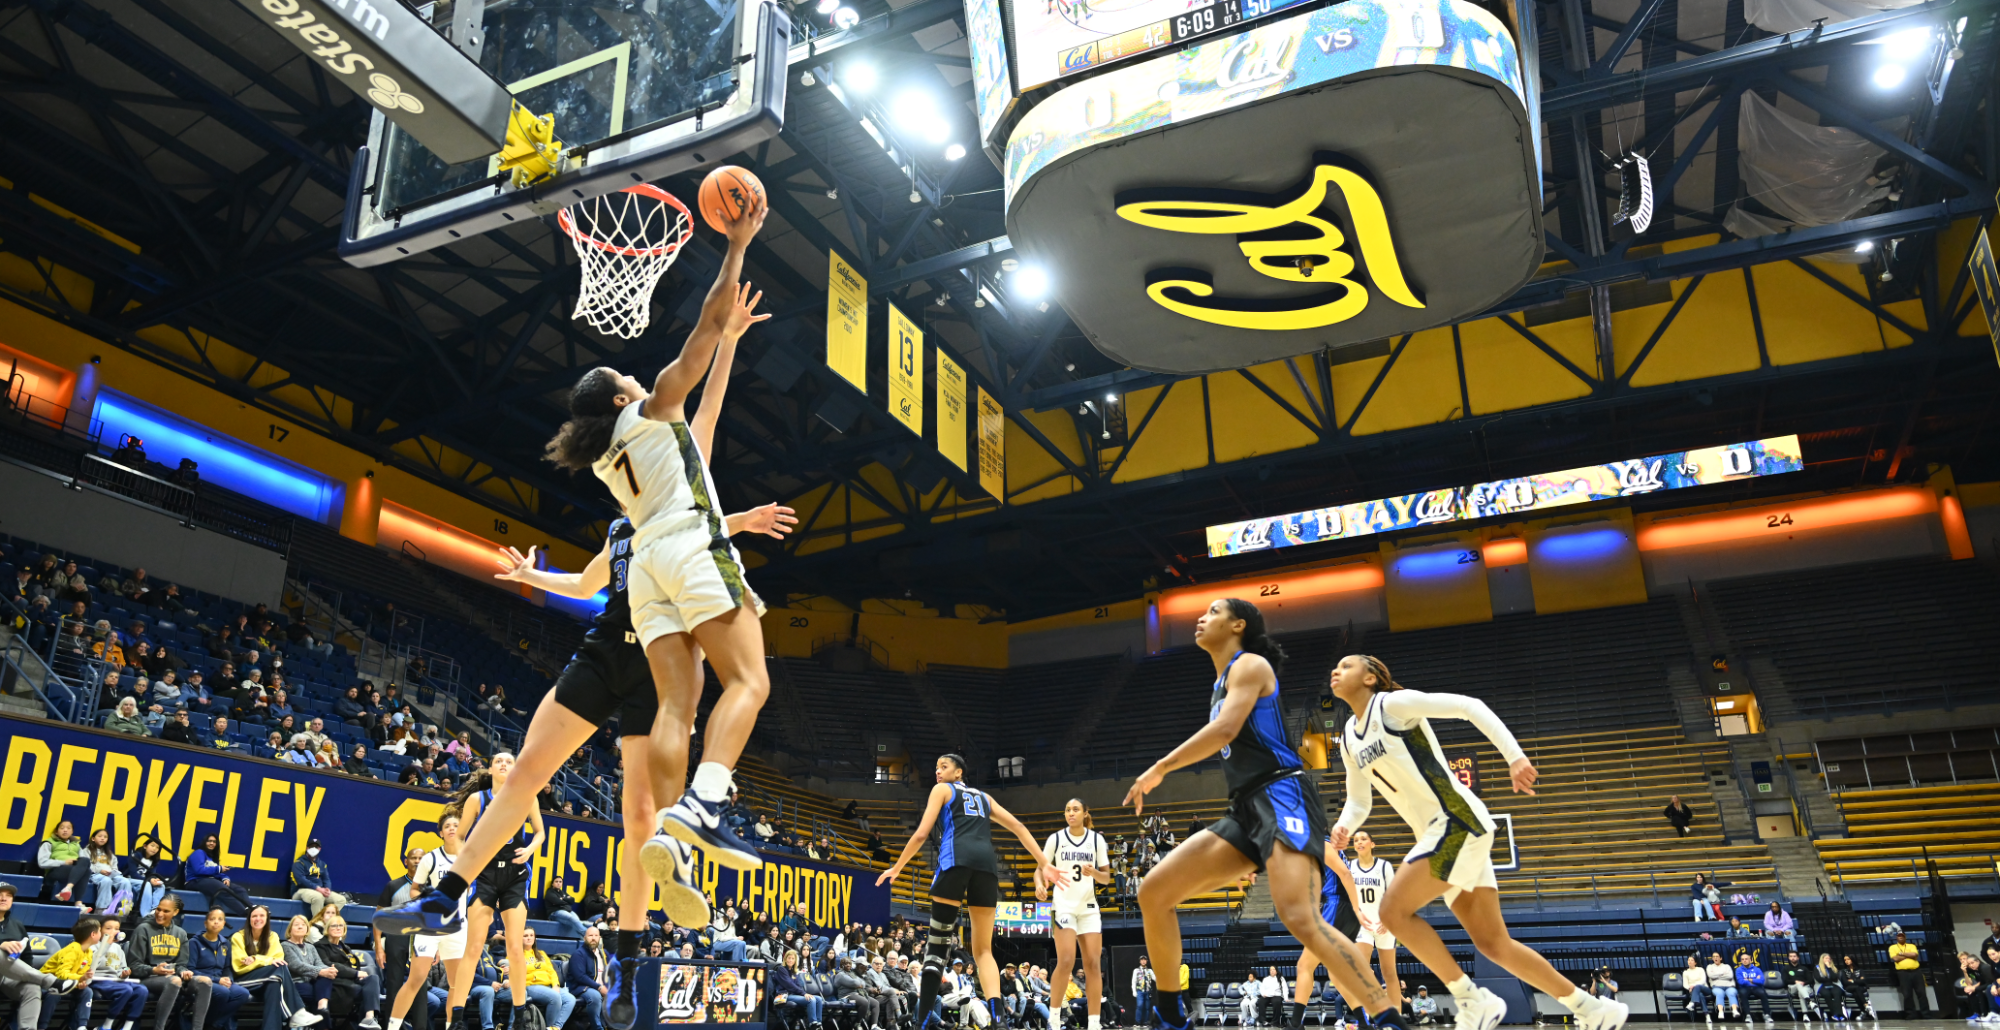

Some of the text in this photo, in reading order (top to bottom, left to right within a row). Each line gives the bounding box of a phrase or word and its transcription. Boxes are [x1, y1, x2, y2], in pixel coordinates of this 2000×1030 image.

[1224, 2, 1237, 14] 14
[1176, 15, 1215, 38] 6:09
[262, 0, 374, 74] State
[1142, 24, 1165, 48] 42
[1064, 46, 1093, 72] Cal
[1216, 36, 1296, 102] Cal
[1315, 28, 1353, 54] vs
[1116, 164, 1426, 330] Cal
[836, 262, 861, 291] California
[899, 329, 914, 377] 13
[900, 398, 911, 417] Cal
[269, 424, 290, 443] 17
[613, 449, 641, 498] 7
[1620, 458, 1664, 496] Cal
[1676, 462, 1699, 475] vs
[1415, 491, 1455, 526] Cal
[494, 518, 508, 535] 18
[1766, 513, 1793, 528] 24
[1236, 522, 1275, 553] Cal
[1282, 523, 1300, 535] vs
[1457, 551, 1480, 564] 23
[1260, 584, 1280, 597] 22
[1094, 607, 1109, 618] 21
[790, 616, 808, 628] 20
[1713, 659, 1727, 669] Cal
[1322, 699, 1333, 708] Cal
[1449, 758, 1472, 770] 6:09
[1372, 768, 1398, 793] 1
[0, 735, 327, 872] BERKELEY
[962, 792, 985, 818] 21
[1284, 816, 1304, 834] D
[1061, 851, 1094, 862] CALIFORNIA
[1072, 864, 1082, 882] 3
[1360, 888, 1375, 903] 10
[1006, 906, 1018, 916] 42
[1026, 909, 1032, 918] 3
[1020, 923, 1044, 934] 6:09
[30, 936, 47, 950] Cal
[659, 969, 698, 1019] Cal
[707, 987, 722, 1003] vs
